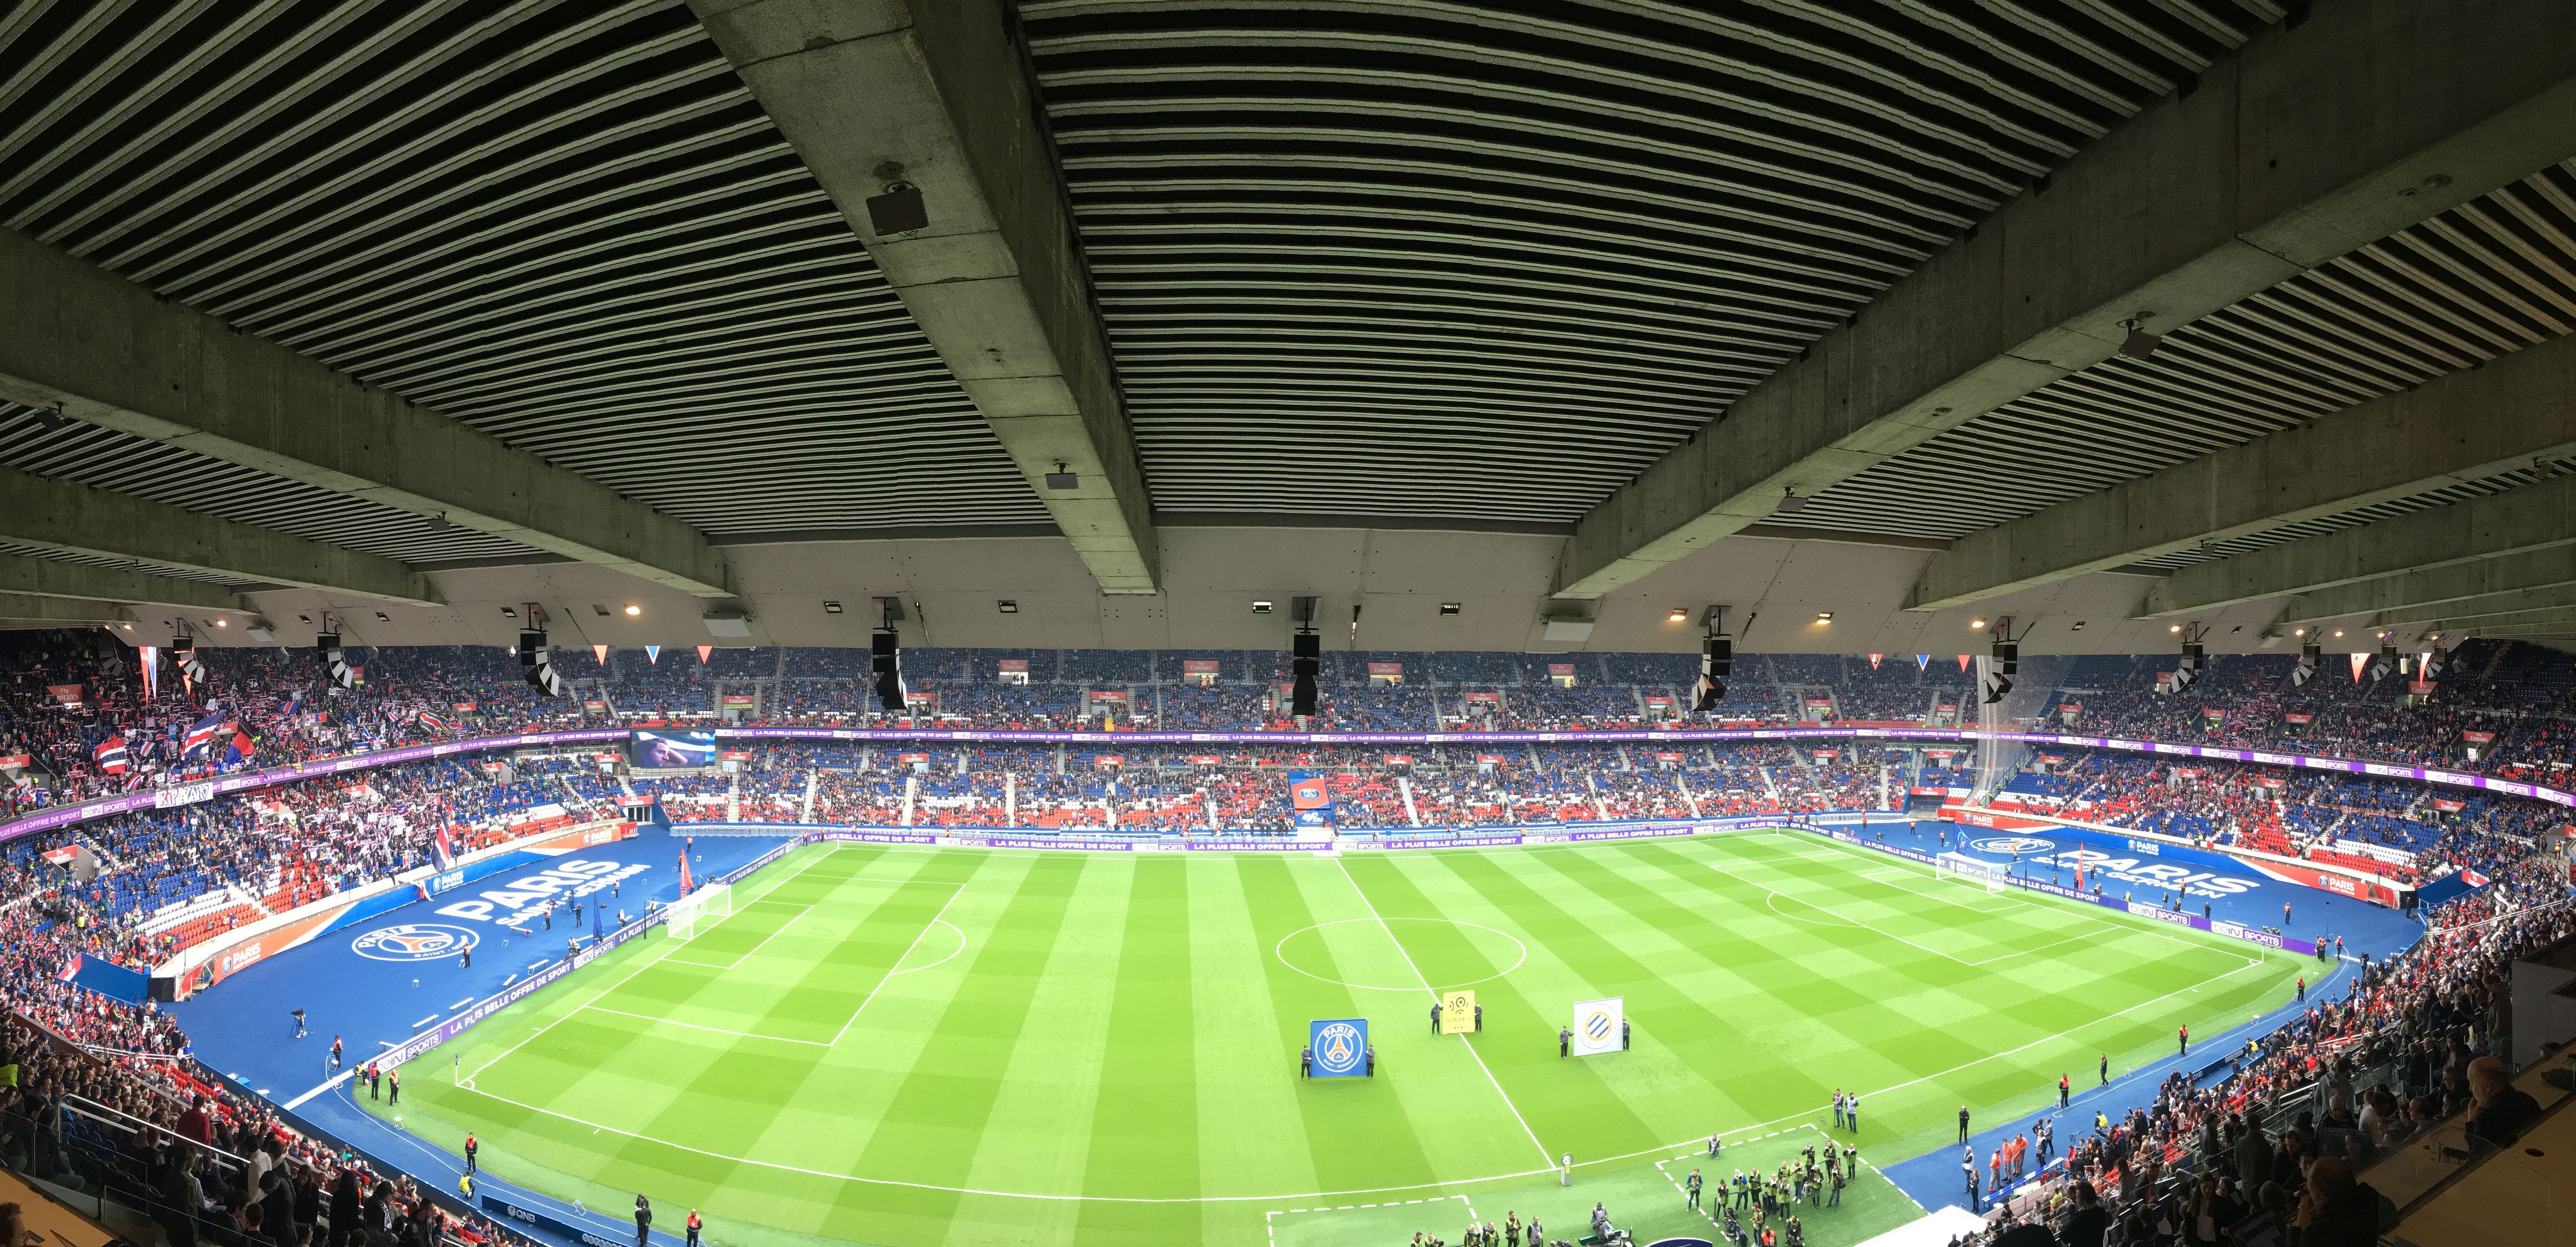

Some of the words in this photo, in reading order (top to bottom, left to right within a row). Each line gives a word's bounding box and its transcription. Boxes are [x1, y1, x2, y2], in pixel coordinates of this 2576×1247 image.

[2388, 767, 2412, 776] SPORTS
[2448, 775, 2472, 784] SPORTS
[84, 806, 101, 816] beIN
[104, 803, 126, 812] SPORTS
[11, 823, 28, 835] BELLE
[29, 818, 49, 829] OFFRE
[61, 811, 80, 821] SPORT
[1973, 815, 1993, 824] PARIS
[591, 830, 612, 840] PARIS
[1884, 846, 1900, 854] BELLE
[1901, 850, 1918, 859] OFFRE
[2137, 842, 2159, 852] PARIS
[736, 870, 746, 879] PLUS
[747, 864, 757, 874] BELLE
[757, 858, 768, 868] OFFRE
[774, 849, 784, 858] SPORT
[2057, 850, 2261, 892] PARIS
[442, 871, 463, 885] PARIS
[2329, 877, 2354, 892] PARIS
[434, 860, 620, 921] PARIS
[2003, 875, 2018, 884] PLUS
[2041, 884, 2063, 894] OFFRE
[2076, 892, 2099, 903] SPORT
[2131, 904, 2153, 916] beIN
[2157, 911, 2187, 924] SPORTS
[358, 926, 416, 948] PARIS
[620, 933, 628, 942] LA
[629, 925, 642, 936] PLUS
[2214, 923, 2240, 936] beIN
[2244, 930, 2279, 946] SPORTS
[233, 943, 261, 965] PARIS
[414, 949, 445, 958] SAINT
[594, 941, 613, 957] SPORTS
[450, 1021, 462, 1034] LA
[485, 995, 509, 1015] BELLE
[511, 982, 535, 1000] OFFRE
[537, 975, 547, 989] DE
[548, 964, 570, 984] SPORT
[1323, 1025, 1355, 1038] PARIS
[407, 1034, 439, 1058] SPORTS
[1323, 1058, 1334, 1068] SAINT
[1337, 1058, 1354, 1068] GERMAIN
[2193, 1071, 2203, 1080] QNB
[516, 1210, 536, 1223] QNB
